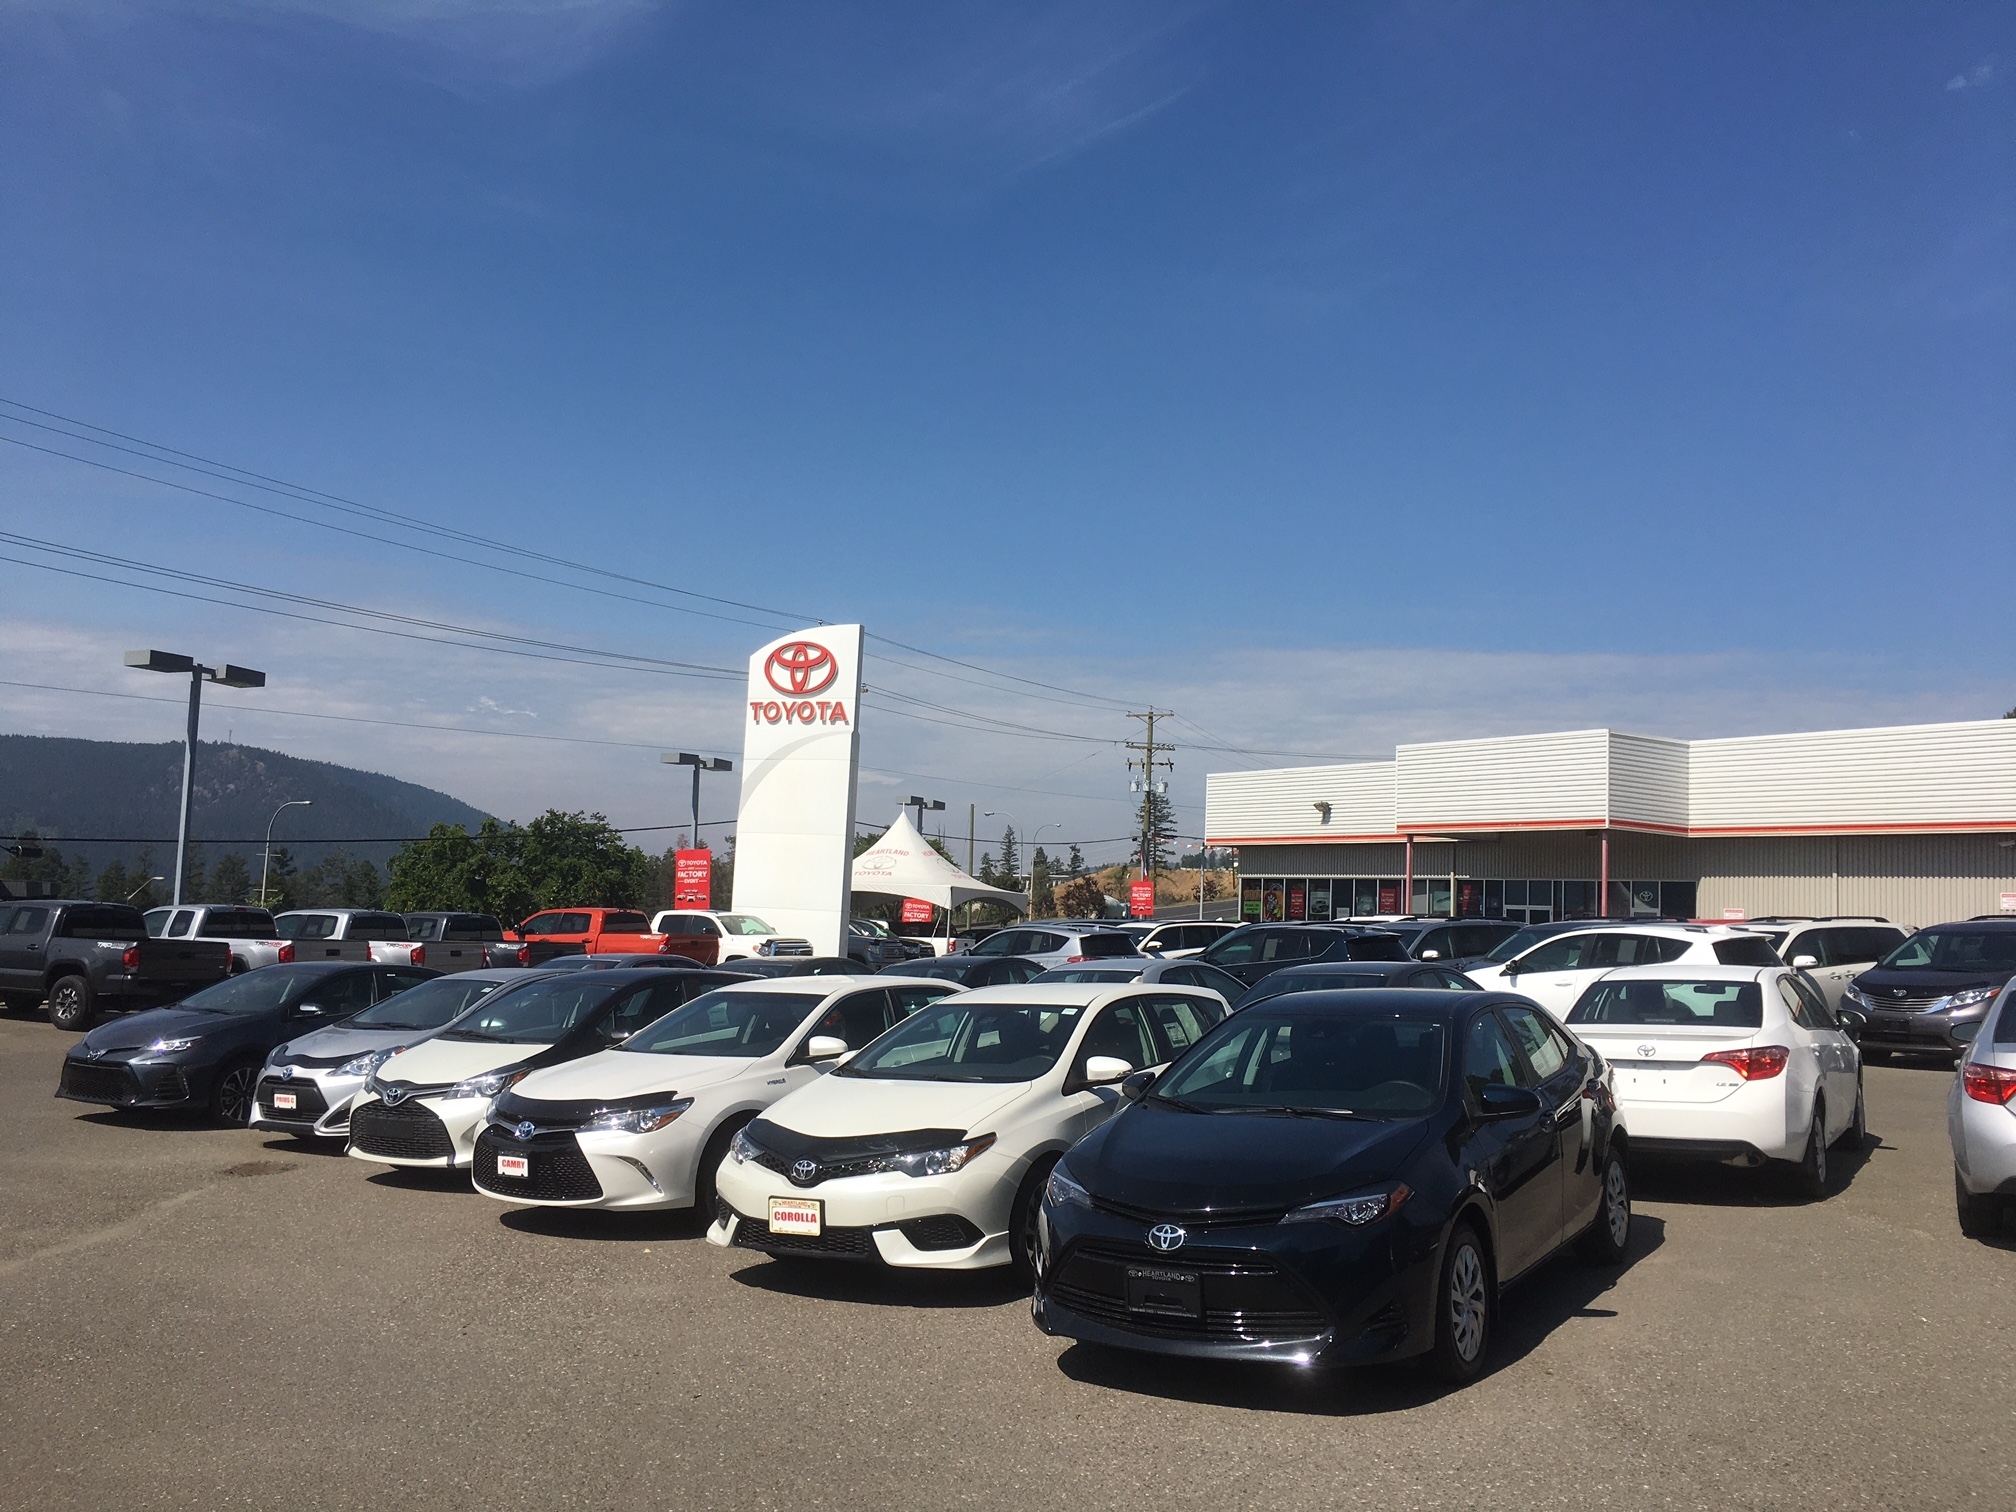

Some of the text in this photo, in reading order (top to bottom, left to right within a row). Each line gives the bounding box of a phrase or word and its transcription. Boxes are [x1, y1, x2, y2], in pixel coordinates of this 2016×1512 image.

[750, 701, 848, 723] TOYOTA
[866, 848, 909, 857] HEARTLAND
[904, 911, 930, 919] FACTORY
[501, 1159, 525, 1169] CAMRY
[774, 1211, 817, 1223] COROLLA
[1142, 1270, 1181, 1281] HEARTLAND
